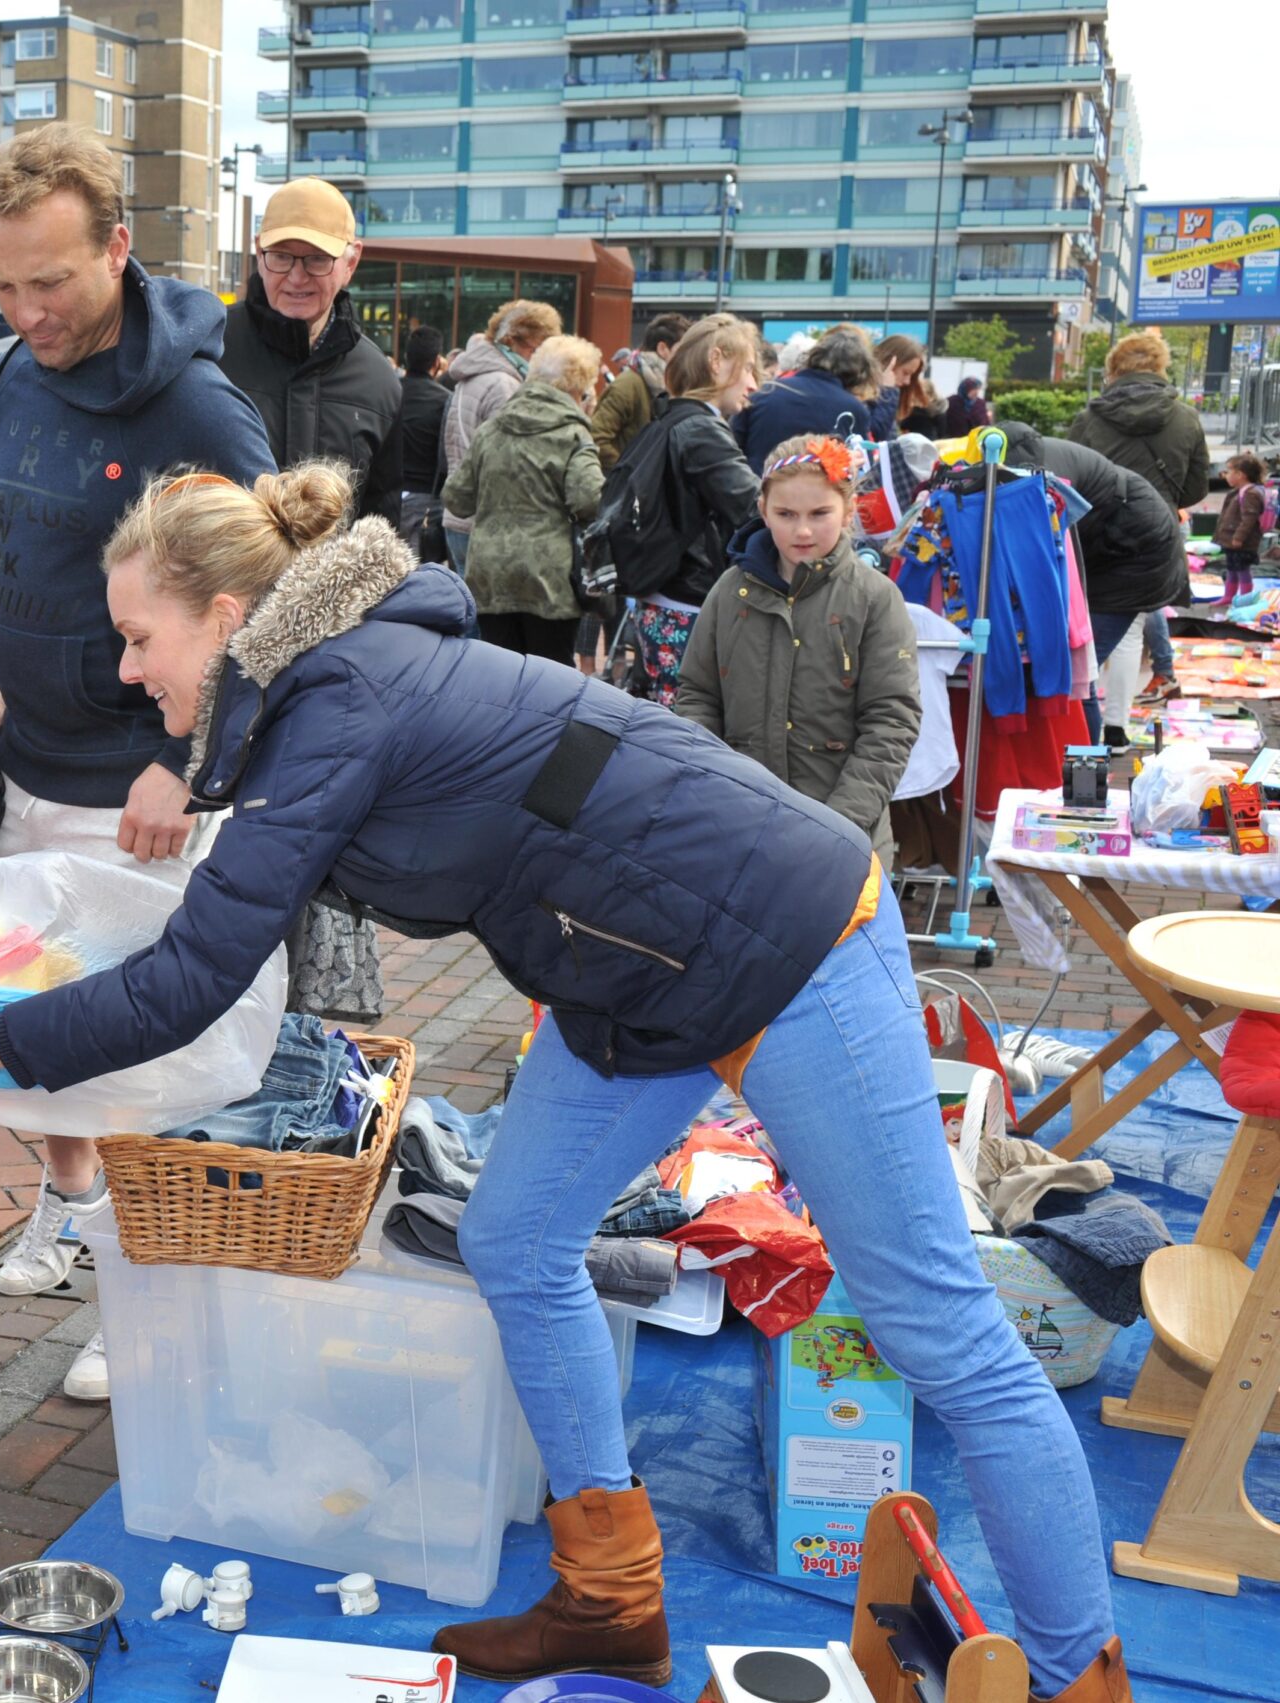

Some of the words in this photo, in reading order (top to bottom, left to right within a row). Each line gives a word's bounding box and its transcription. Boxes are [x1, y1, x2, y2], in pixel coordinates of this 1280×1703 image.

[1152, 251, 1195, 267] BEDANKT
[1197, 244, 1225, 256] VOOR
[1226, 240, 1243, 249] UW
[1245, 231, 1275, 245] STEM!
[8, 420, 105, 456] UPER
[826, 1500, 850, 1508] spelen
[850, 1501, 872, 1510] kken,
[826, 1521, 855, 1532] Garage
[802, 1556, 839, 1578] Toet
